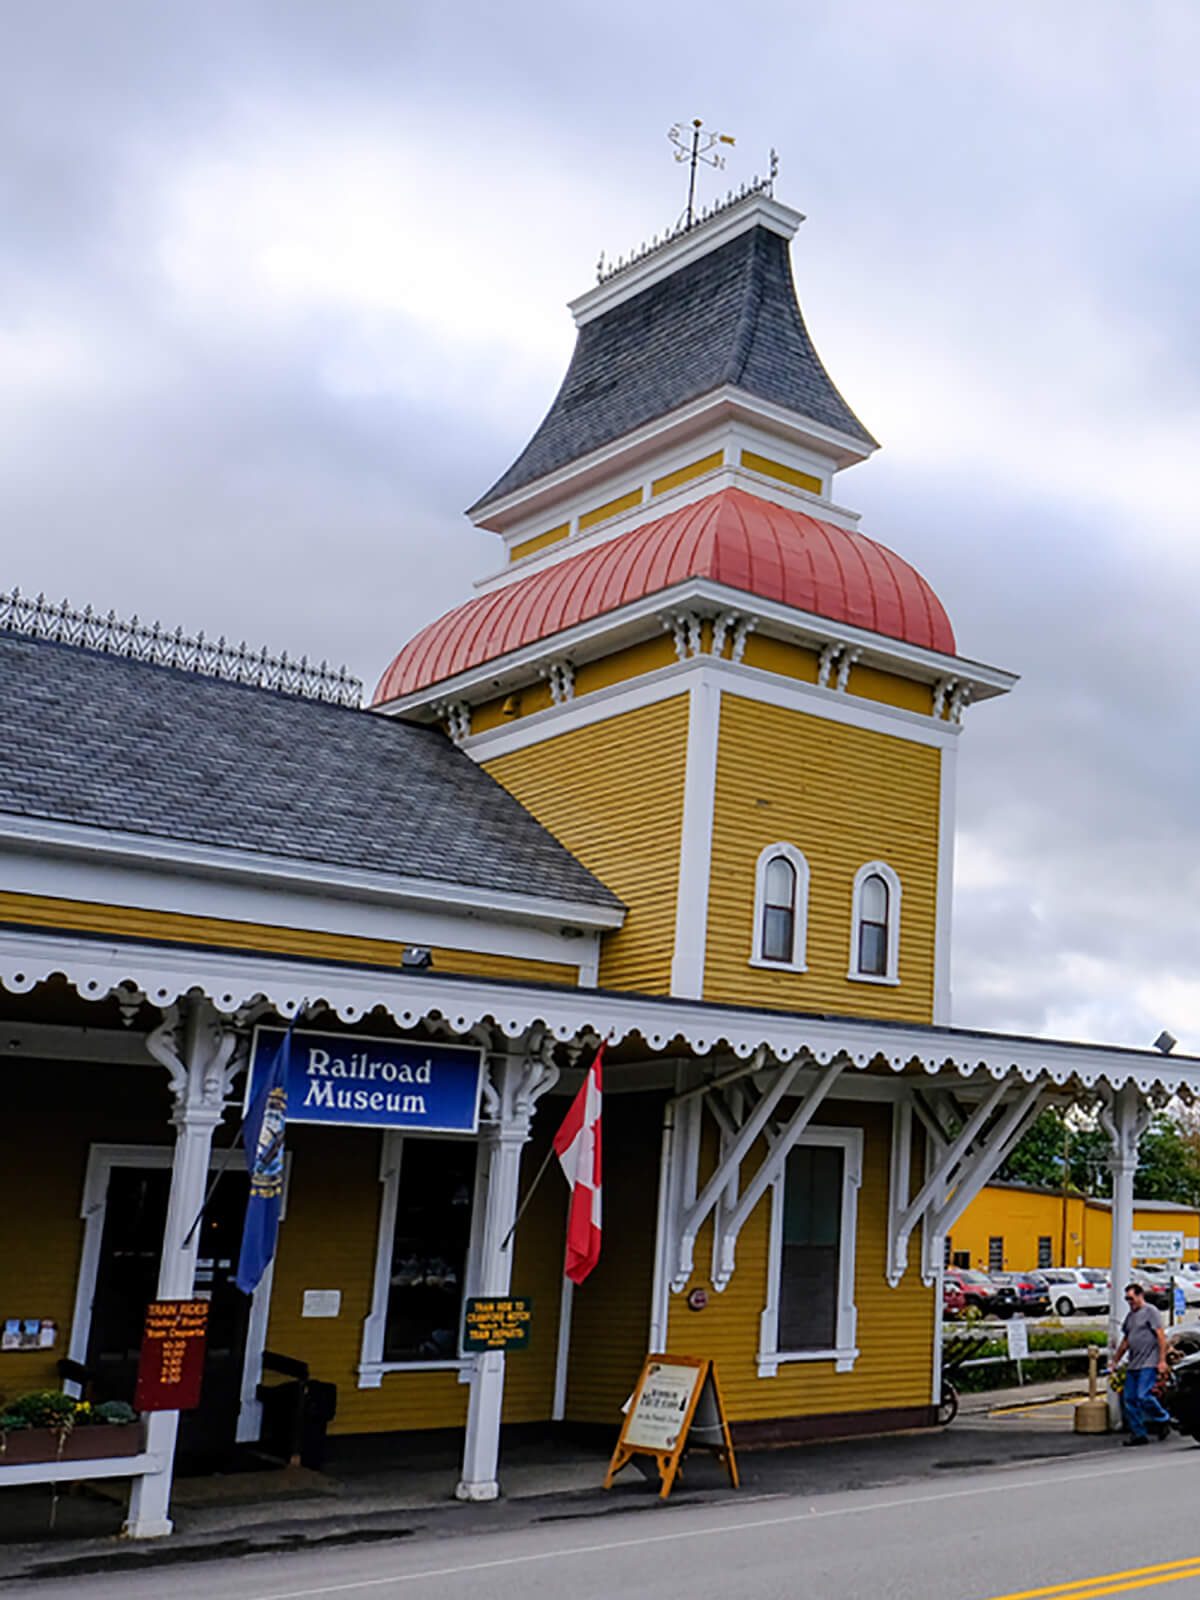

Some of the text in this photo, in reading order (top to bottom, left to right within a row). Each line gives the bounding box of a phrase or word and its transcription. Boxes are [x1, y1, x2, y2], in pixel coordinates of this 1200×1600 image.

[306, 1048, 432, 1084] Railroad
[303, 1079, 427, 1114] Museum
[147, 1303, 209, 1316] TRAIN RIDES
[474, 1301, 525, 1312] TRAIN RIDE TO
[467, 1311, 530, 1324] CRAWFORD NOTCH
[169, 1328, 206, 1338] Departs
[469, 1329, 491, 1340] TRAIN
